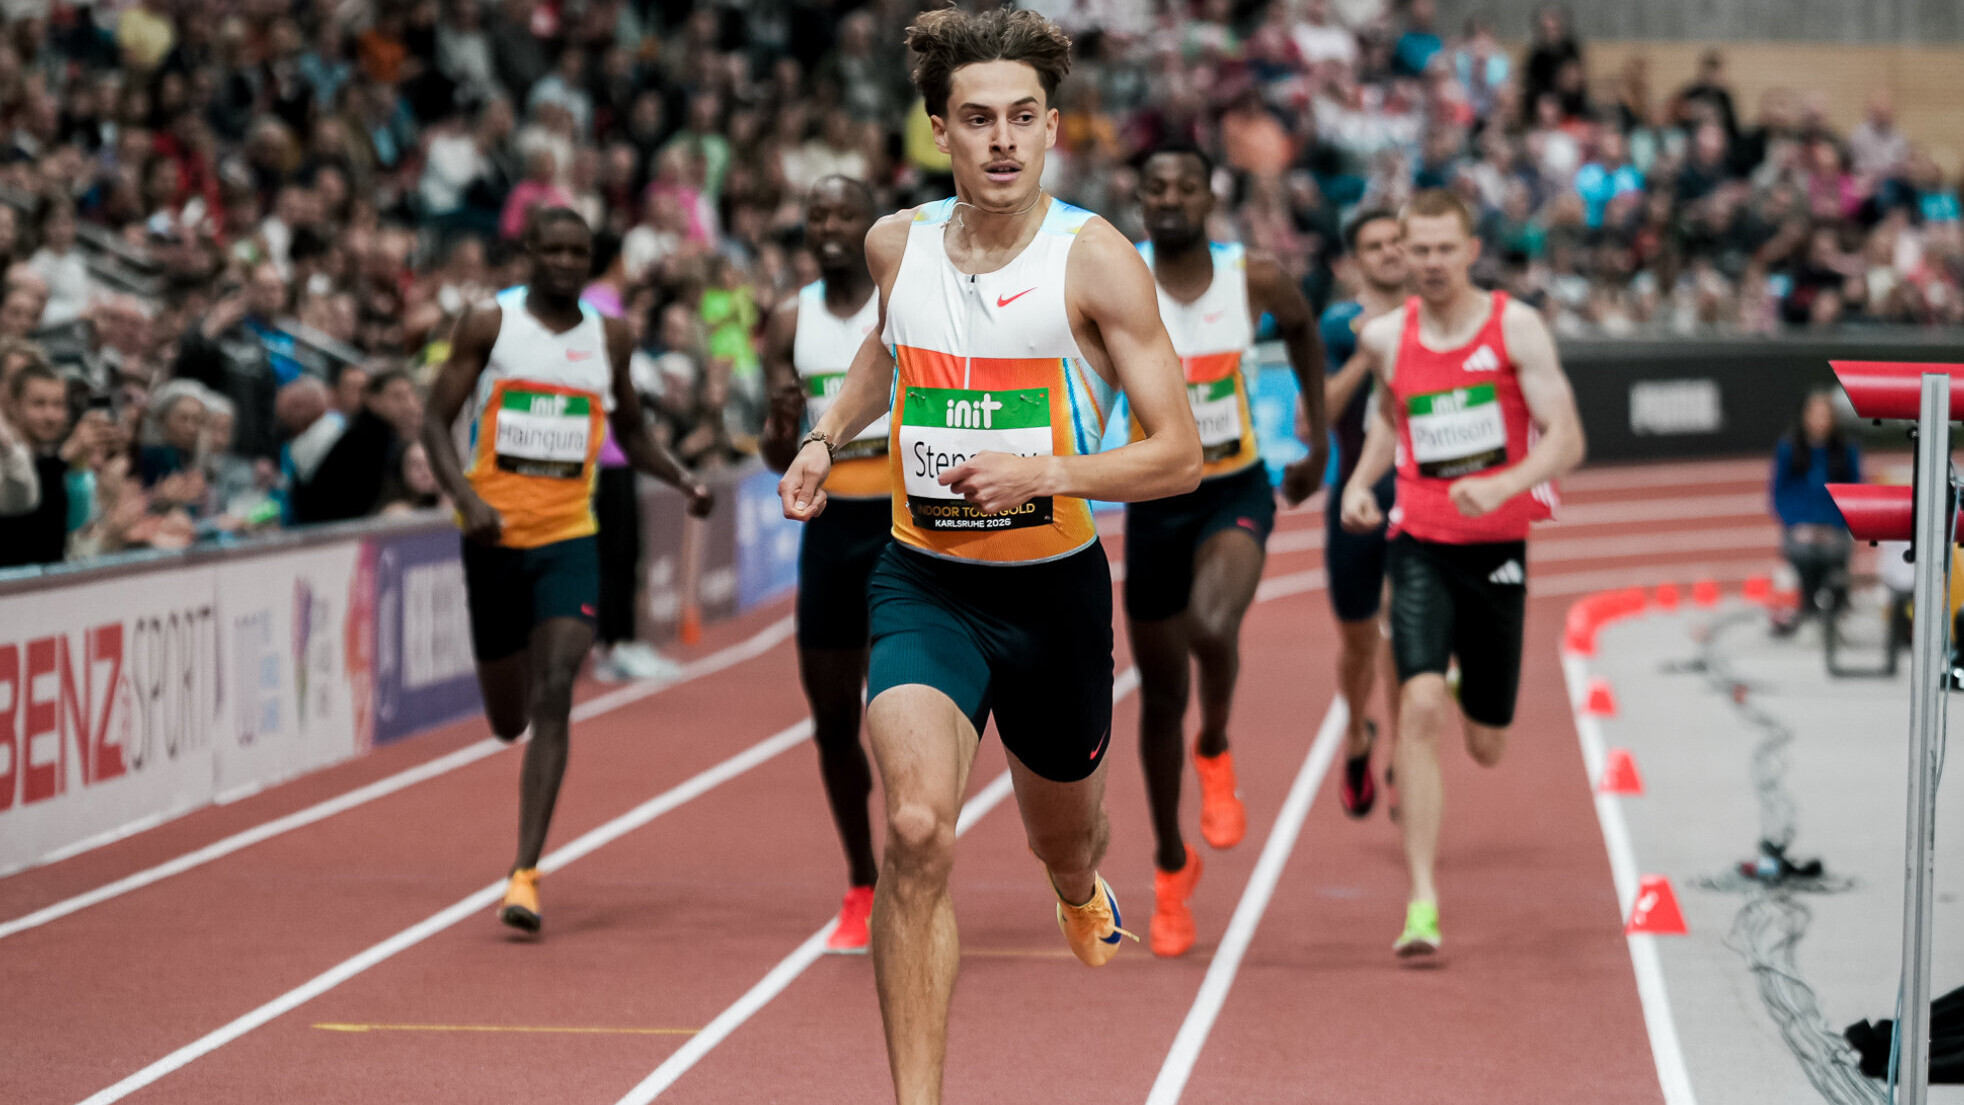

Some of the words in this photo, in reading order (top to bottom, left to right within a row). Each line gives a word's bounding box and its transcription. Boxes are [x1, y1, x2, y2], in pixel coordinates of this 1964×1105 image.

[946, 393, 1003, 429] init
[1415, 420, 1494, 446] Pattison
[935, 519, 984, 528] KARLSRUHE
[986, 518, 1011, 528] 2026
